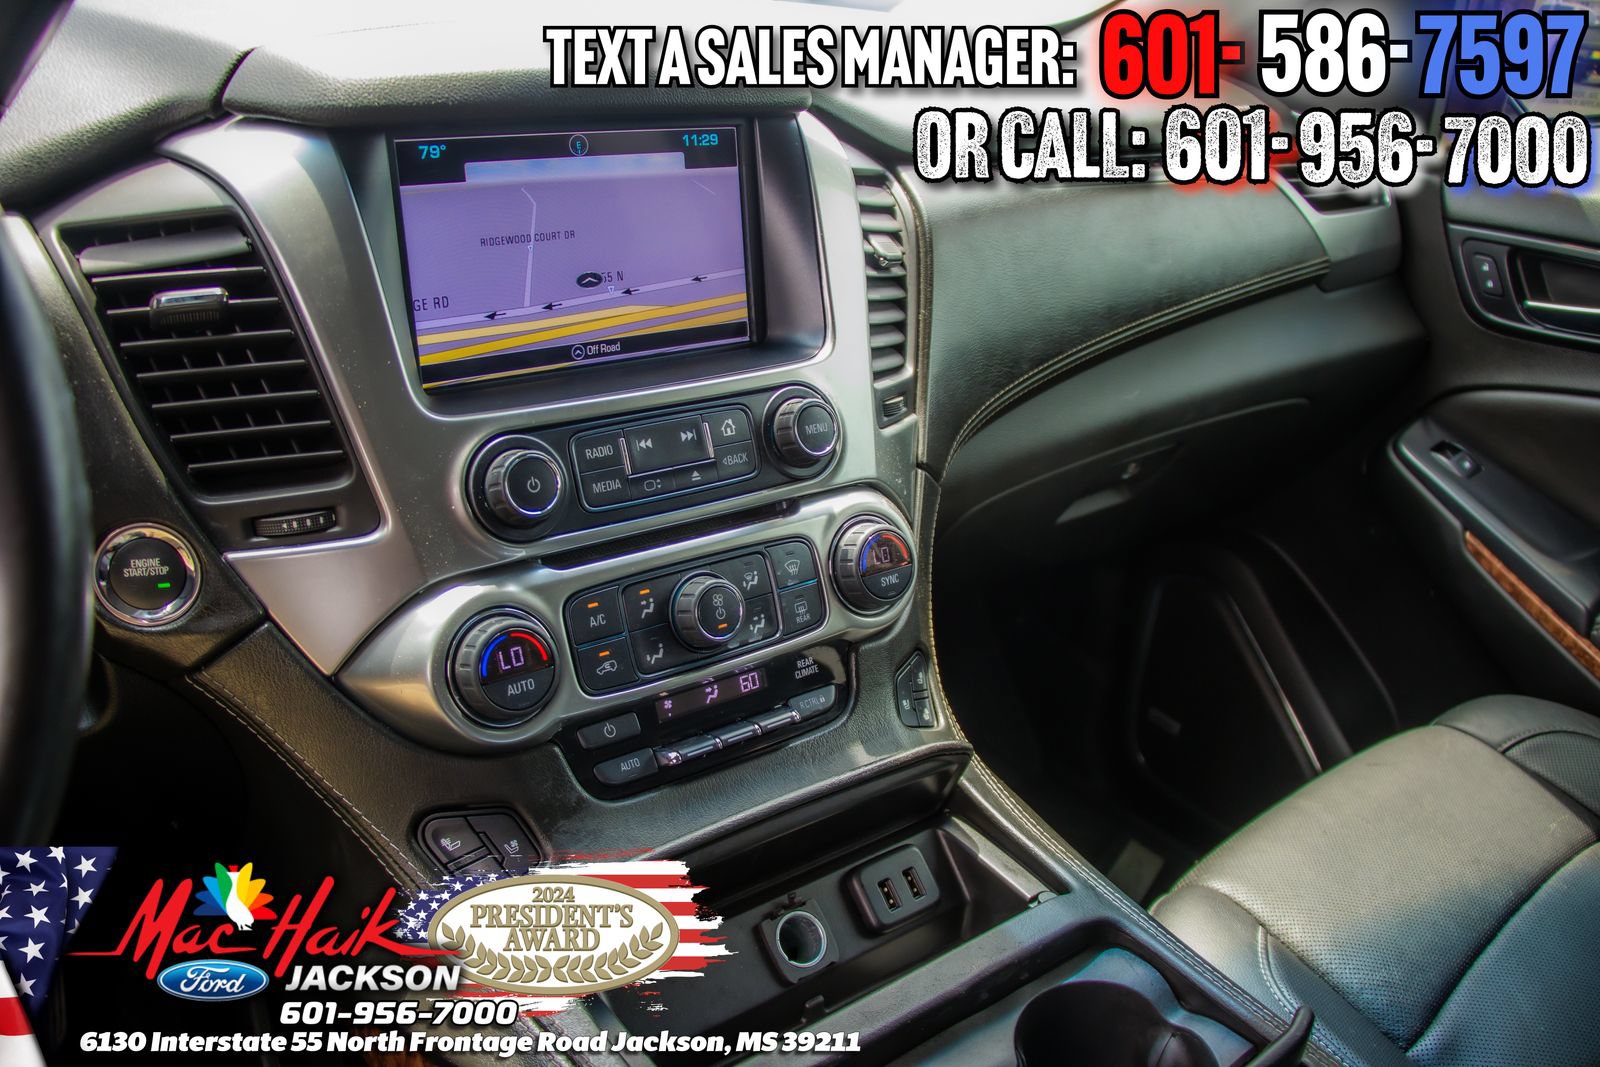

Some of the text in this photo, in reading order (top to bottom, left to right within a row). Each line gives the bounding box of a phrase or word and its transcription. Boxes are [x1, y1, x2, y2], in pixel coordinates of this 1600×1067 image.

[682, 133, 719, 147] 11:29
[479, 230, 576, 247] RIDGEWOOD COURT DR
[616, 270, 624, 281] N
[433, 295, 449, 309] RD
[587, 341, 621, 356] Off Road
[805, 422, 828, 436] MENU
[585, 444, 614, 460] RADIO
[592, 479, 622, 495] MEDIA
[130, 557, 161, 568] ENGINE
[123, 565, 169, 577] START/STOP
[880, 573, 900, 587] SYNC
[589, 613, 607, 629] A/C
[796, 613, 811, 624] REAR
[497, 646, 525, 672] LO
[797, 656, 814, 668] REAR
[794, 664, 819, 680] CLIMATE
[506, 678, 536, 697] AUTO
[739, 670, 760, 695] 60
[619, 756, 641, 773] AUTO
